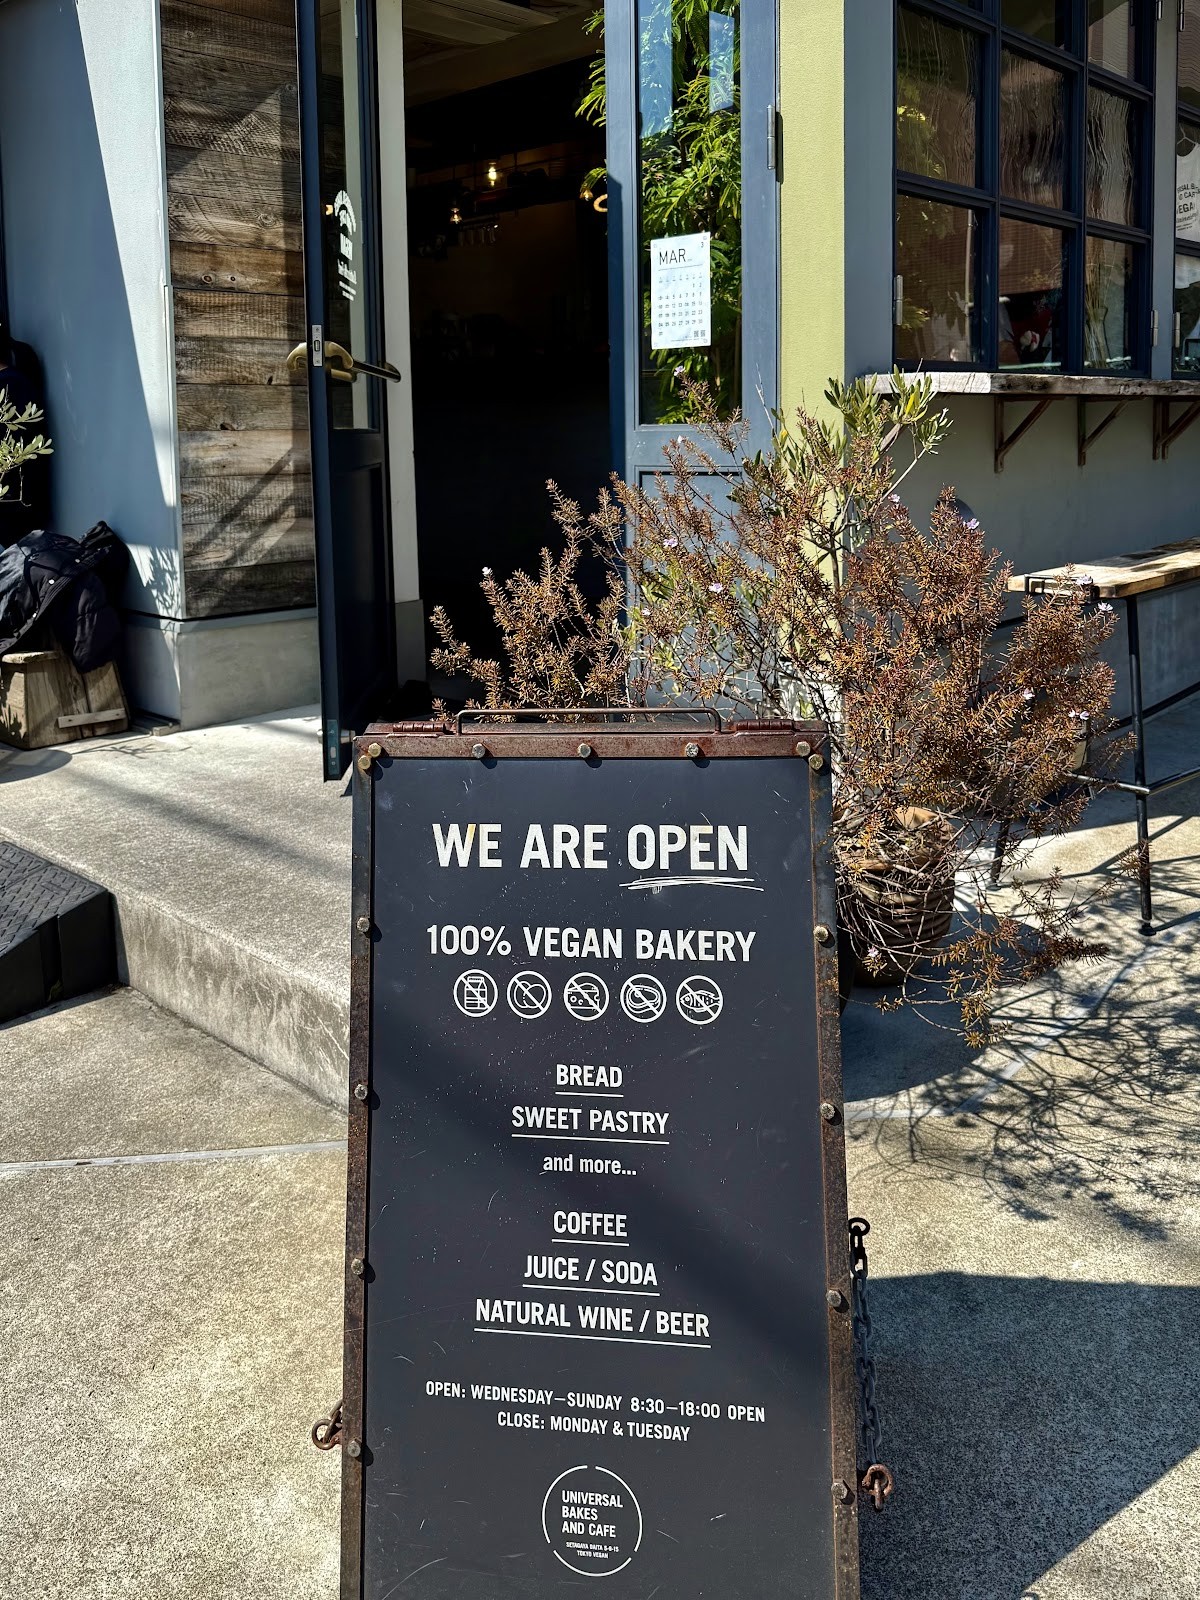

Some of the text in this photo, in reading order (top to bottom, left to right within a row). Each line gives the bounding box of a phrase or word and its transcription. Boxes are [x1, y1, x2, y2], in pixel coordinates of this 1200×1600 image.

[659, 248, 686, 266] MAR
[432, 824, 747, 870] WE ARE OPEN
[427, 925, 756, 961] 100% VEGAN BAKERY
[557, 1064, 622, 1087] BREAD
[512, 1106, 669, 1134] SWEET PASTRY
[543, 1154, 636, 1175] and more...
[554, 1211, 627, 1236] COFFEE
[524, 1255, 657, 1286] JUICE / SODA
[476, 1299, 709, 1337] NATURAL WINE / BEER
[426, 1381, 465, 1398] OPEN:
[728, 1405, 764, 1422] OPEN
[498, 1412, 690, 1441] CLOSE: MONDAY & TUESDAY
[562, 1490, 623, 1507] UNIVERSAL
[562, 1506, 598, 1520] BAKES
[562, 1521, 616, 1537] AND CAFE
